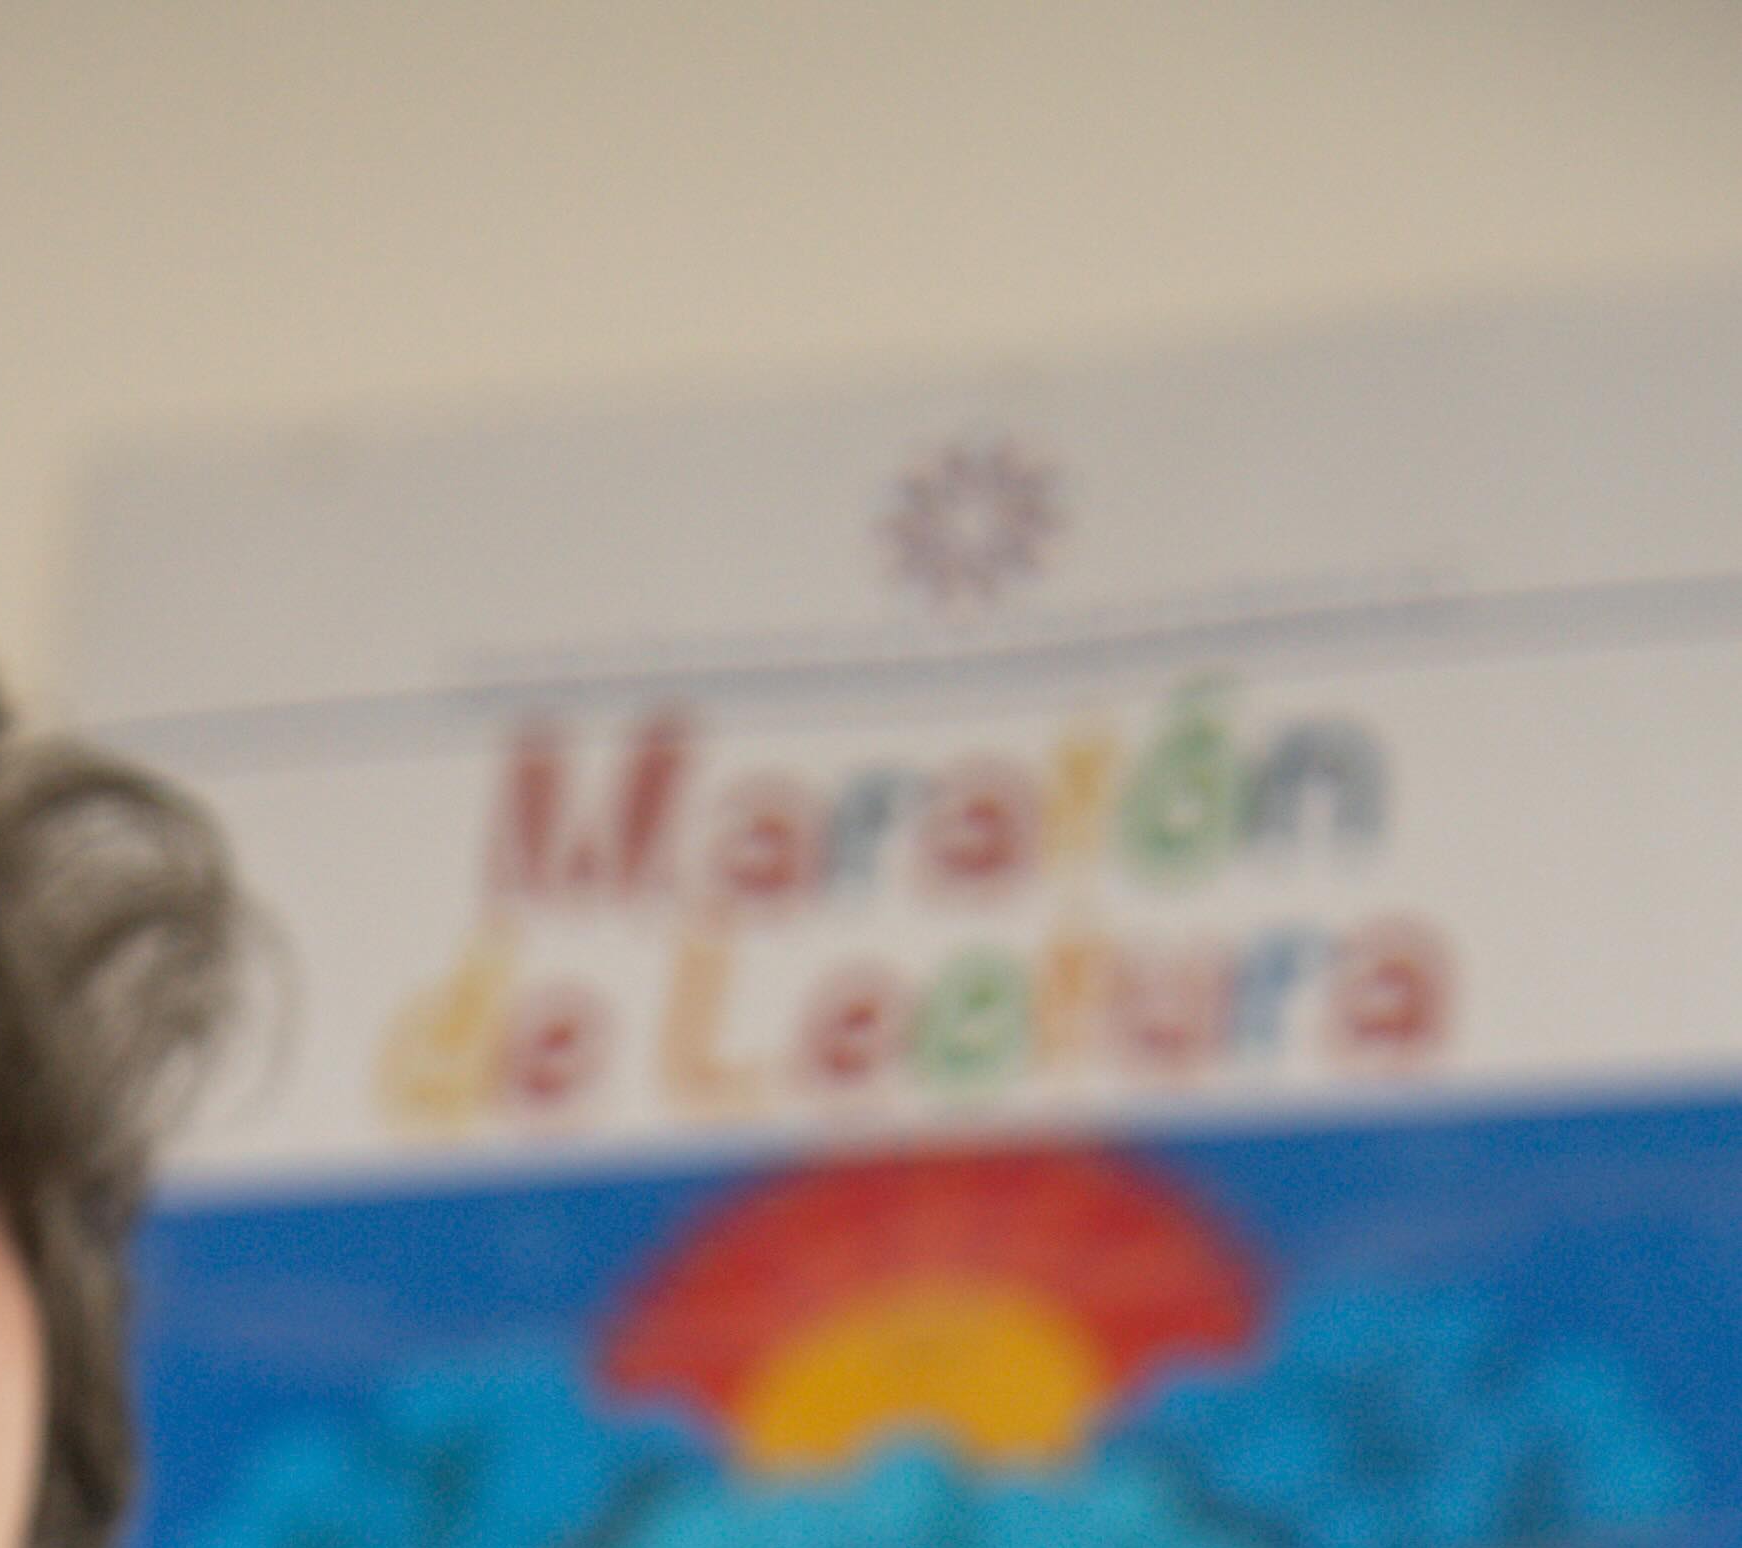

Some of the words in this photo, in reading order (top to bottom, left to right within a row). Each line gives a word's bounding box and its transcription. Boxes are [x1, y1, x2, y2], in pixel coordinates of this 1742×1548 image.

[493, 672, 1390, 905] Maratón
[376, 915, 603, 1125] de
[656, 912, 1448, 1110] Lectura
